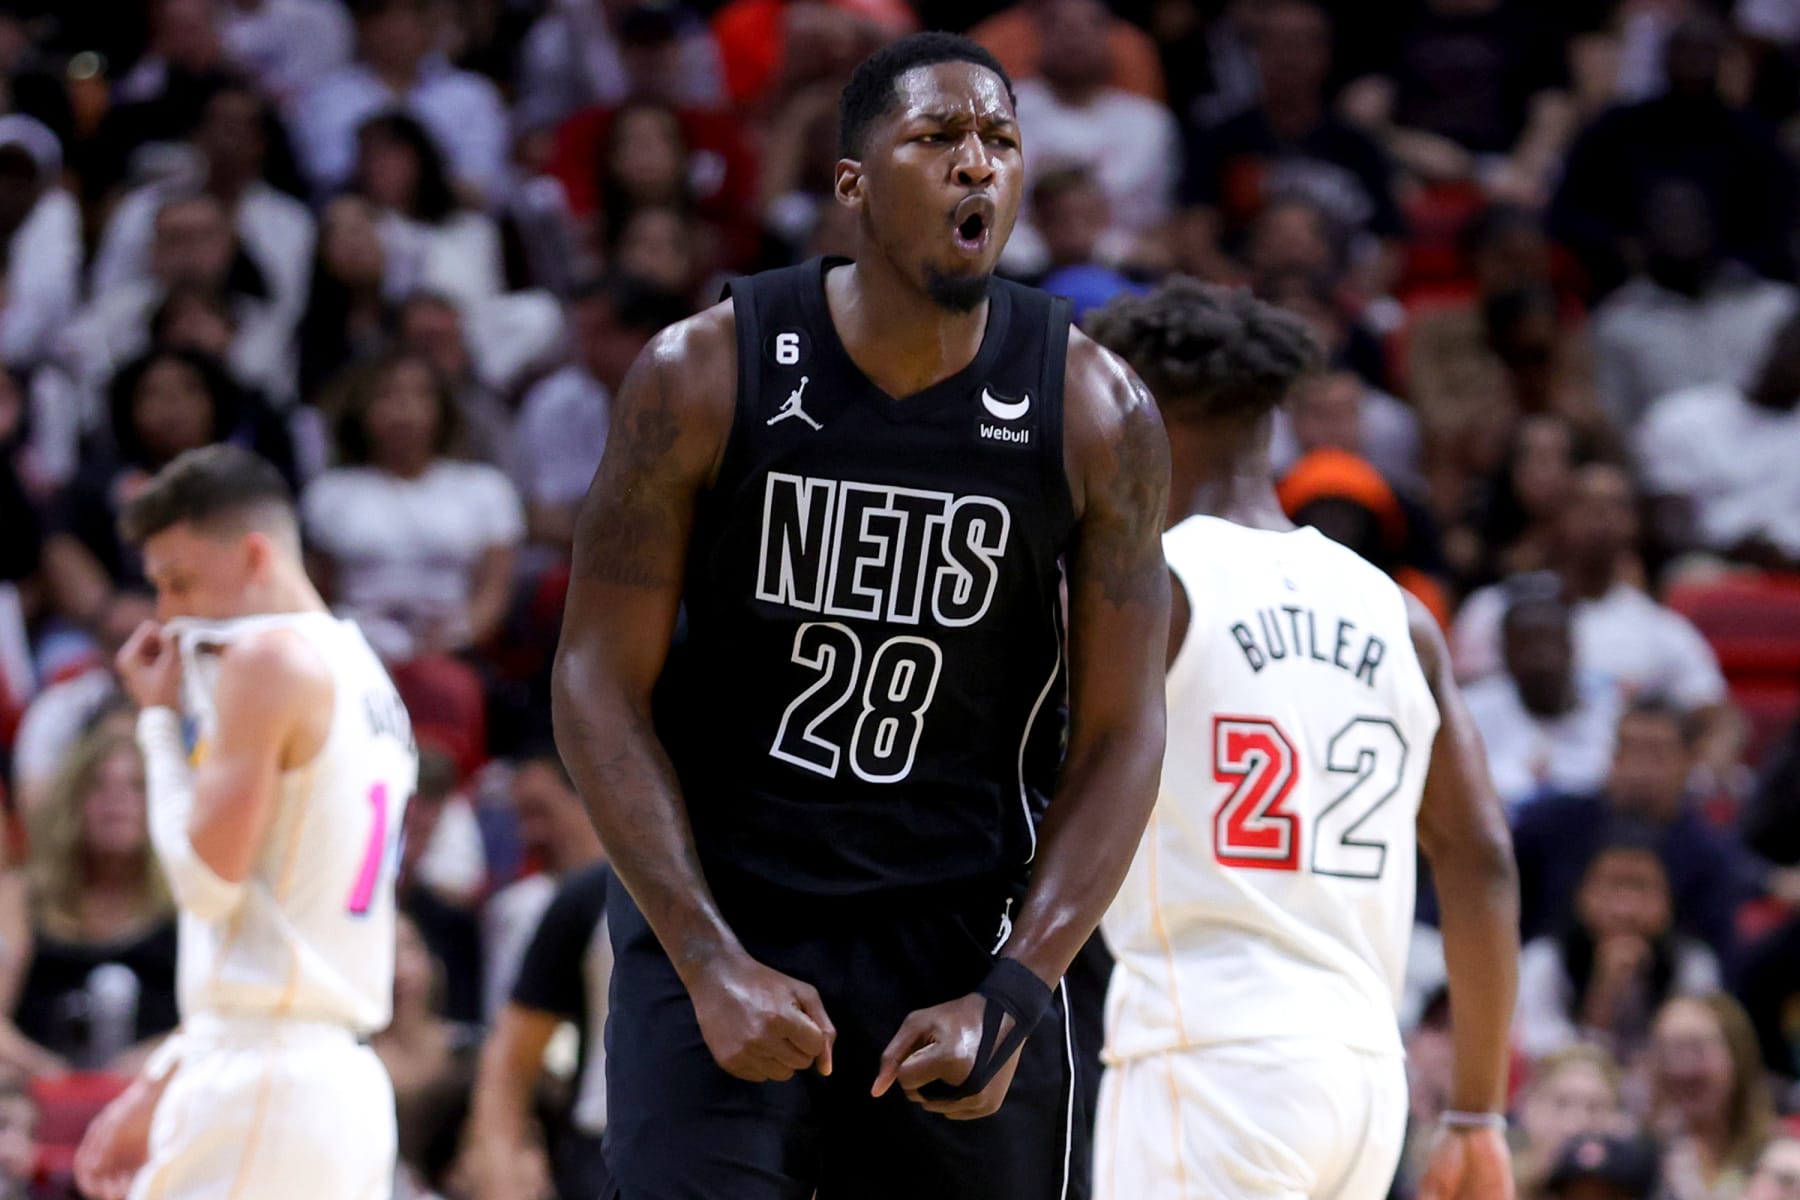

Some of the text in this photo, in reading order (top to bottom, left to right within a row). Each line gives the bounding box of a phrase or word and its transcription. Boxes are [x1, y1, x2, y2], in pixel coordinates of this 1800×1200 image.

[776, 333, 800, 365] 6
[980, 423, 1030, 444] Webull
[755, 471, 1011, 627] NETS
[769, 621, 943, 784] 28
[1231, 605, 1386, 688] BUTLER
[1212, 714, 1409, 879] 22
